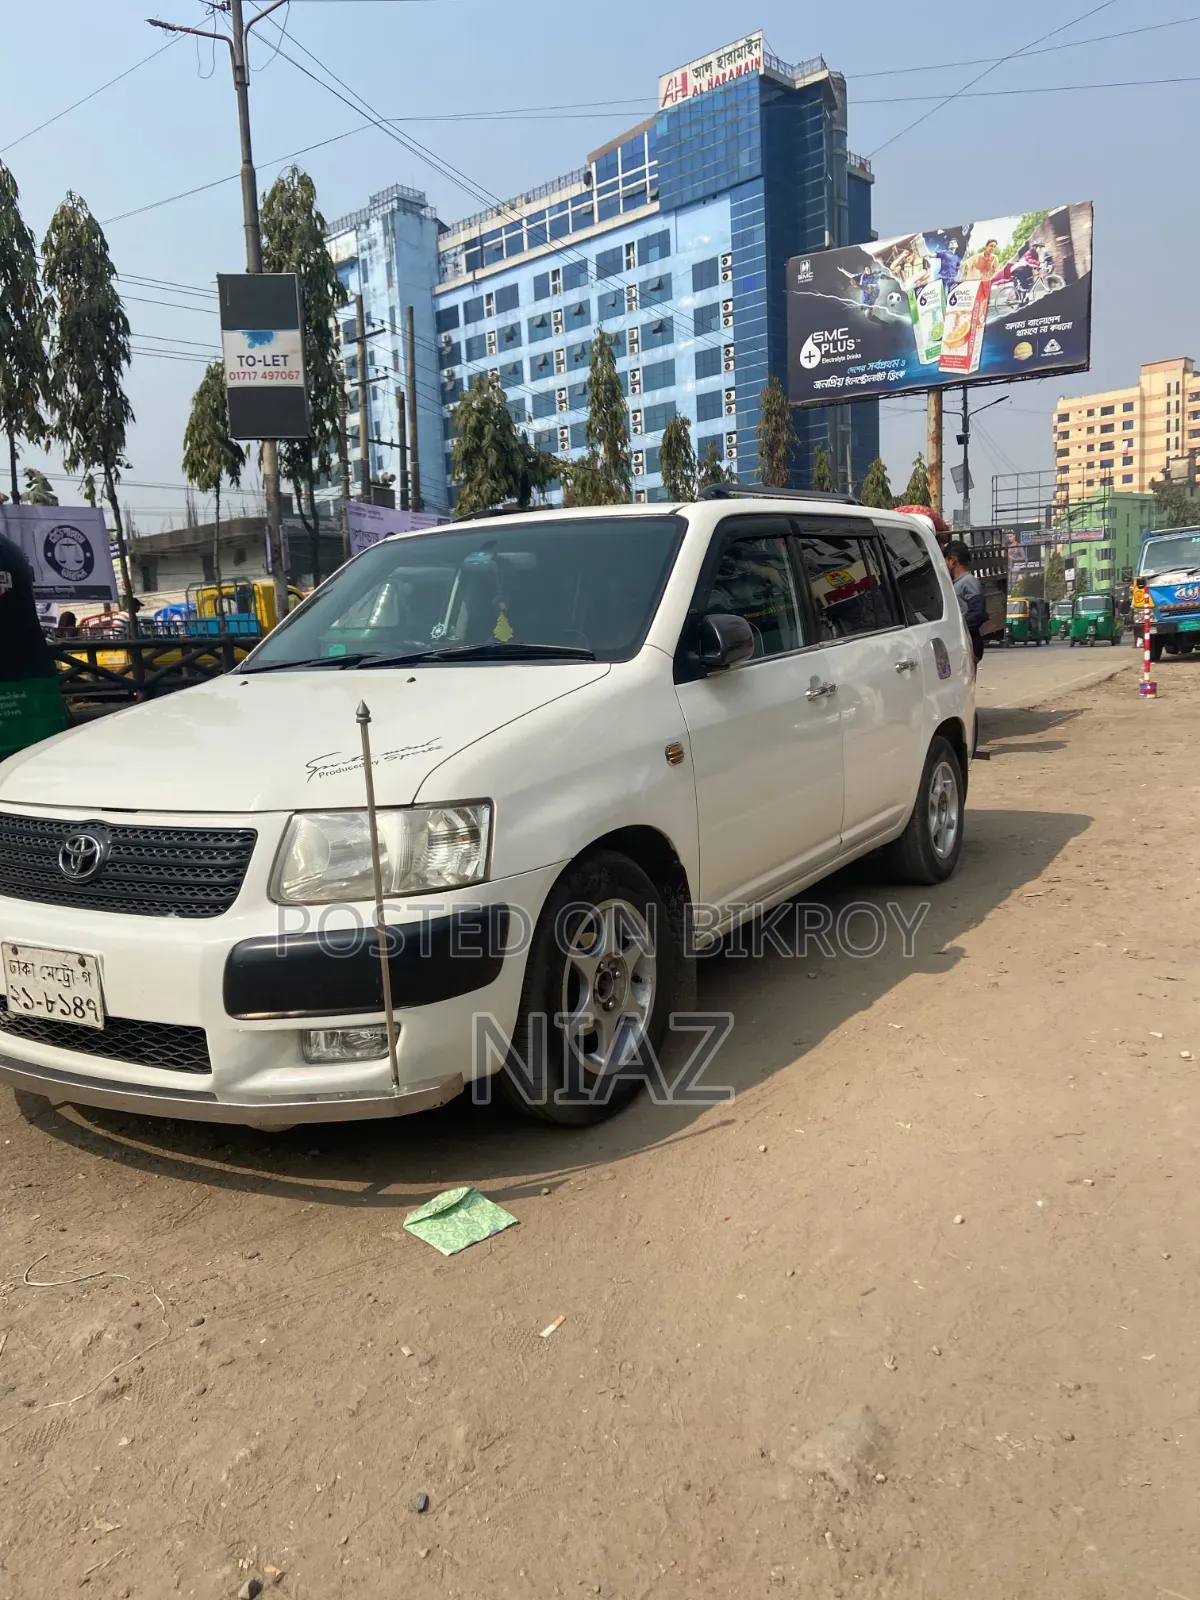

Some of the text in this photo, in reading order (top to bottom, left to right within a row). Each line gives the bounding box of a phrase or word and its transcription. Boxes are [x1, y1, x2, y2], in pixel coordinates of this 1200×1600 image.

[716, 38, 761, 69] হারামাইন
[692, 57, 761, 97] AL HARAMAIN
[1027, 315, 1061, 327] বাংলাদেশ
[813, 328, 849, 343] SMC
[236, 354, 289, 367] TO-LET
[229, 370, 300, 380] 01717 497067
[10, 984, 99, 1022] ২১-৮১৪৭
